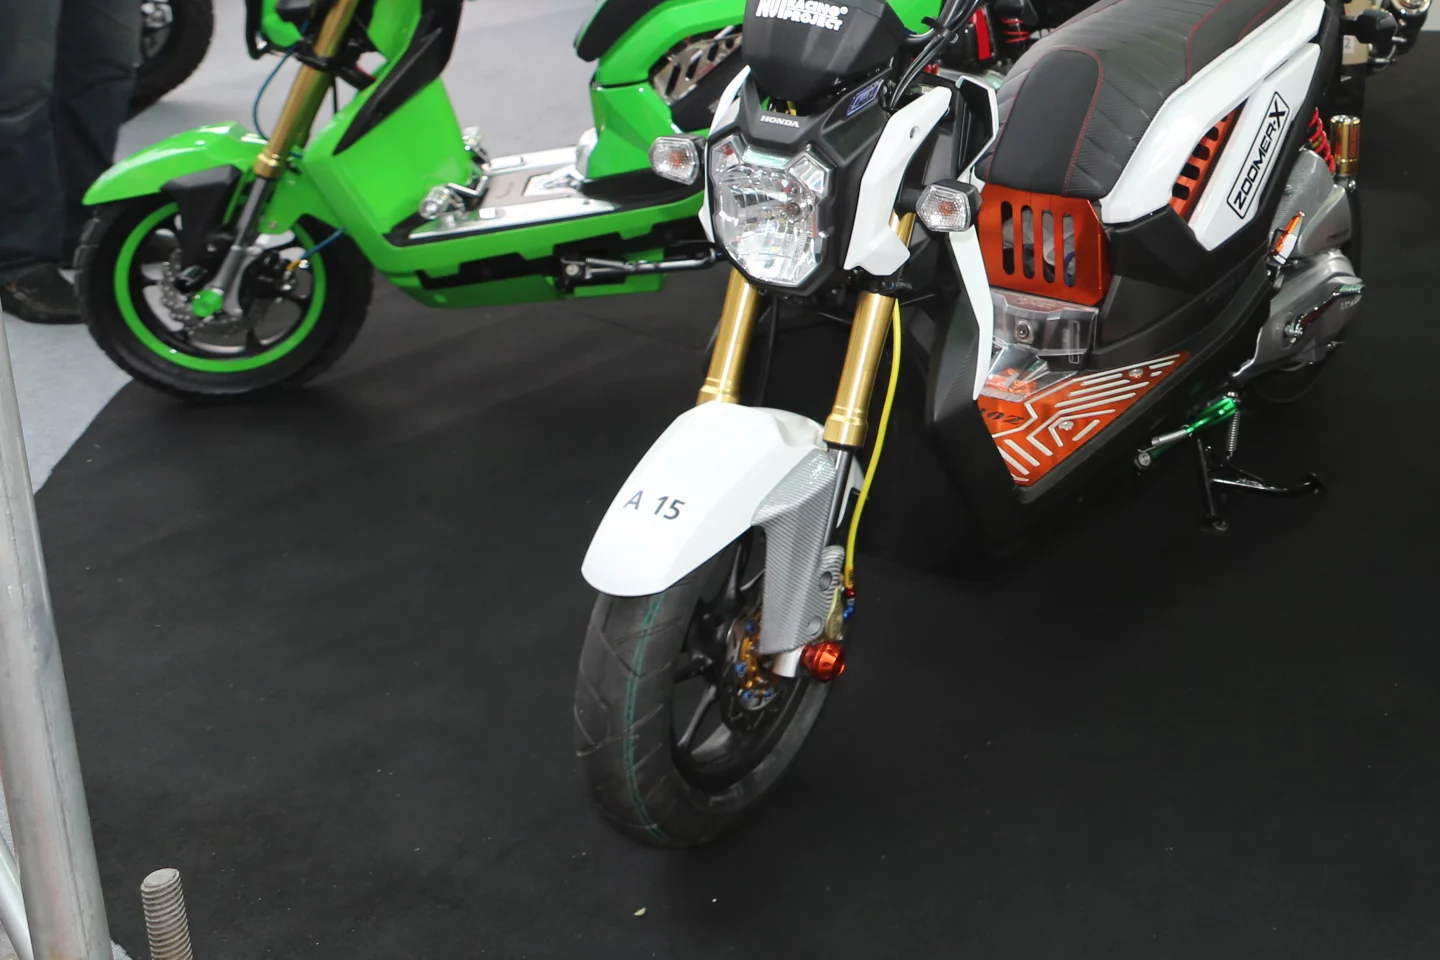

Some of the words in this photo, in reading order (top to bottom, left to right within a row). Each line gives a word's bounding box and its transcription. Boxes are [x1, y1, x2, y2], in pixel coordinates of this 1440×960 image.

[783, 10, 844, 31] PROJECT
[760, 114, 801, 129] HONDA
[1233, 100, 1287, 210] ZOOMER-X
[622, 490, 644, 510] A
[653, 496, 686, 520] 15
